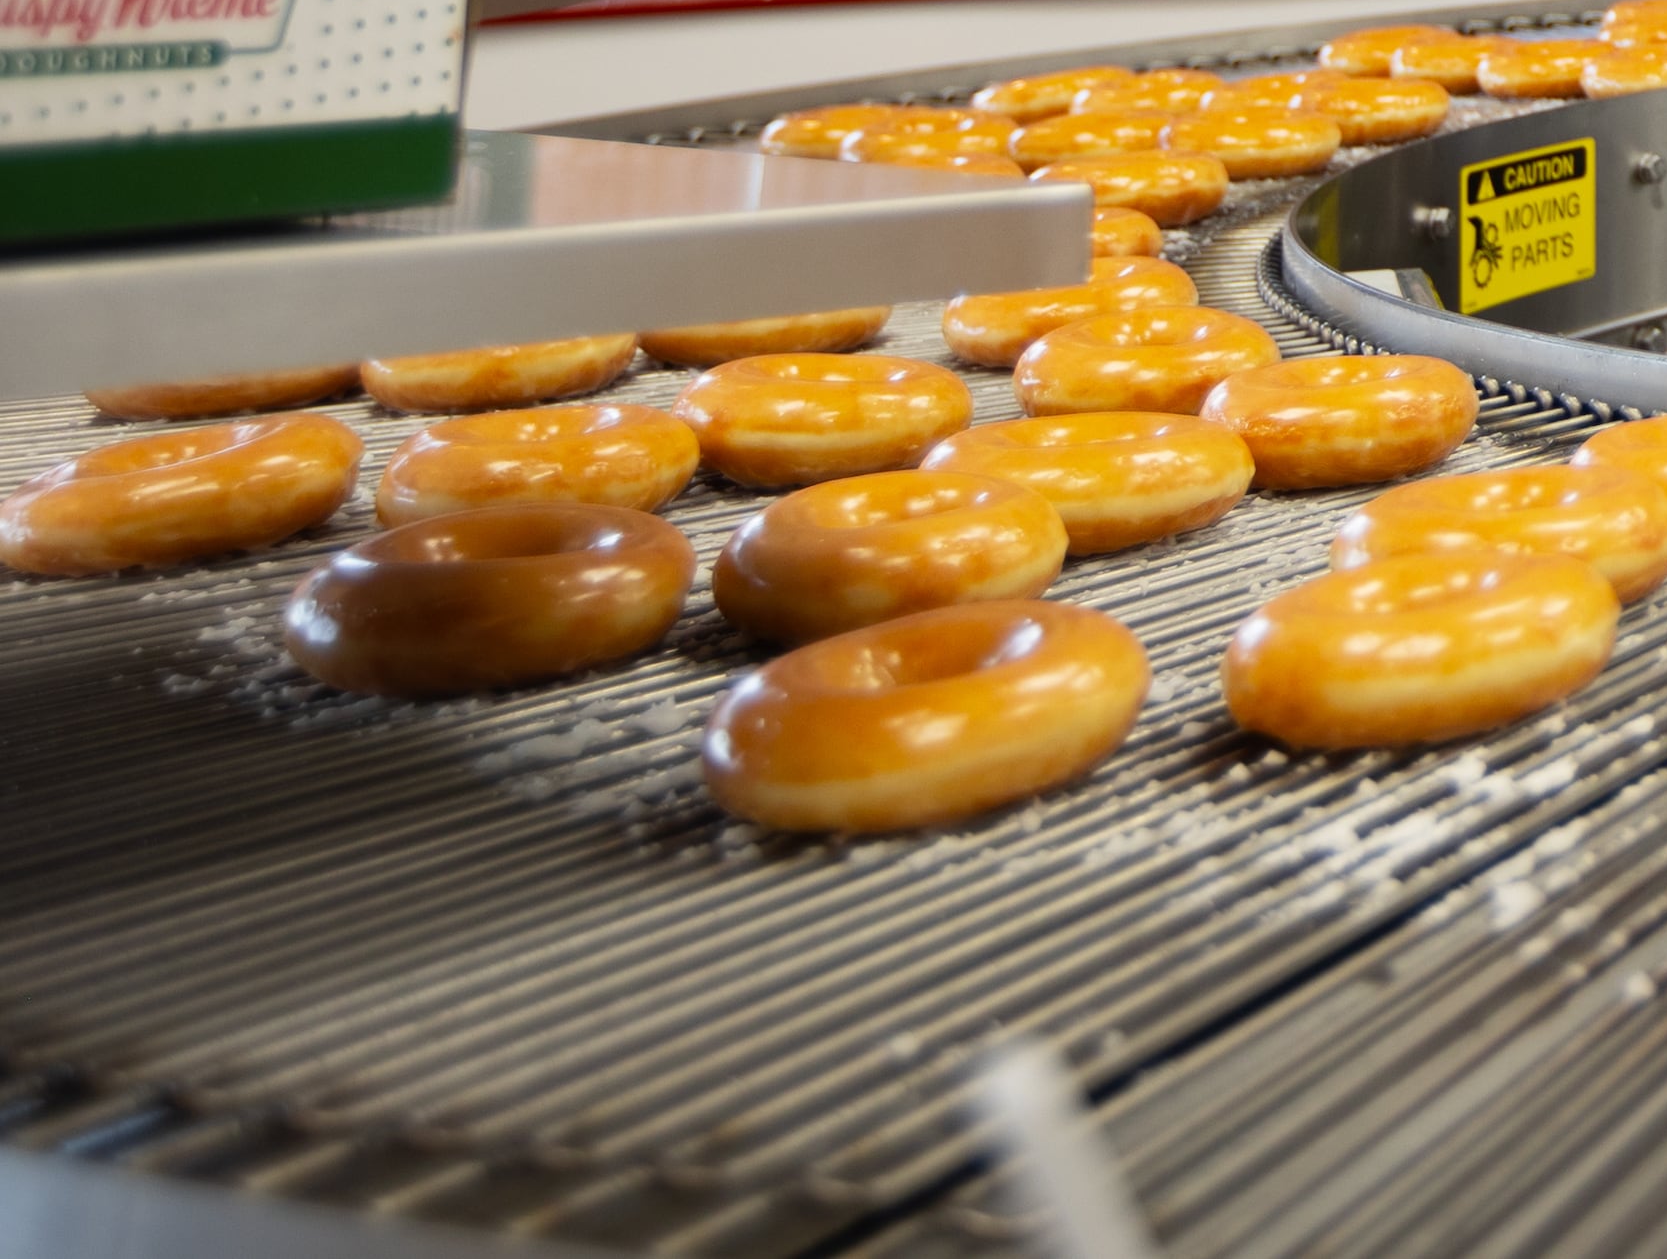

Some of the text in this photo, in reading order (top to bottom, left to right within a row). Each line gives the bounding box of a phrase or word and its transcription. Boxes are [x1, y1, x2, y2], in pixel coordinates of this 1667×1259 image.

[1503, 153, 1575, 191] CAUTION
[1505, 192, 1582, 234] MOVING
[1511, 232, 1574, 272] PARTS
